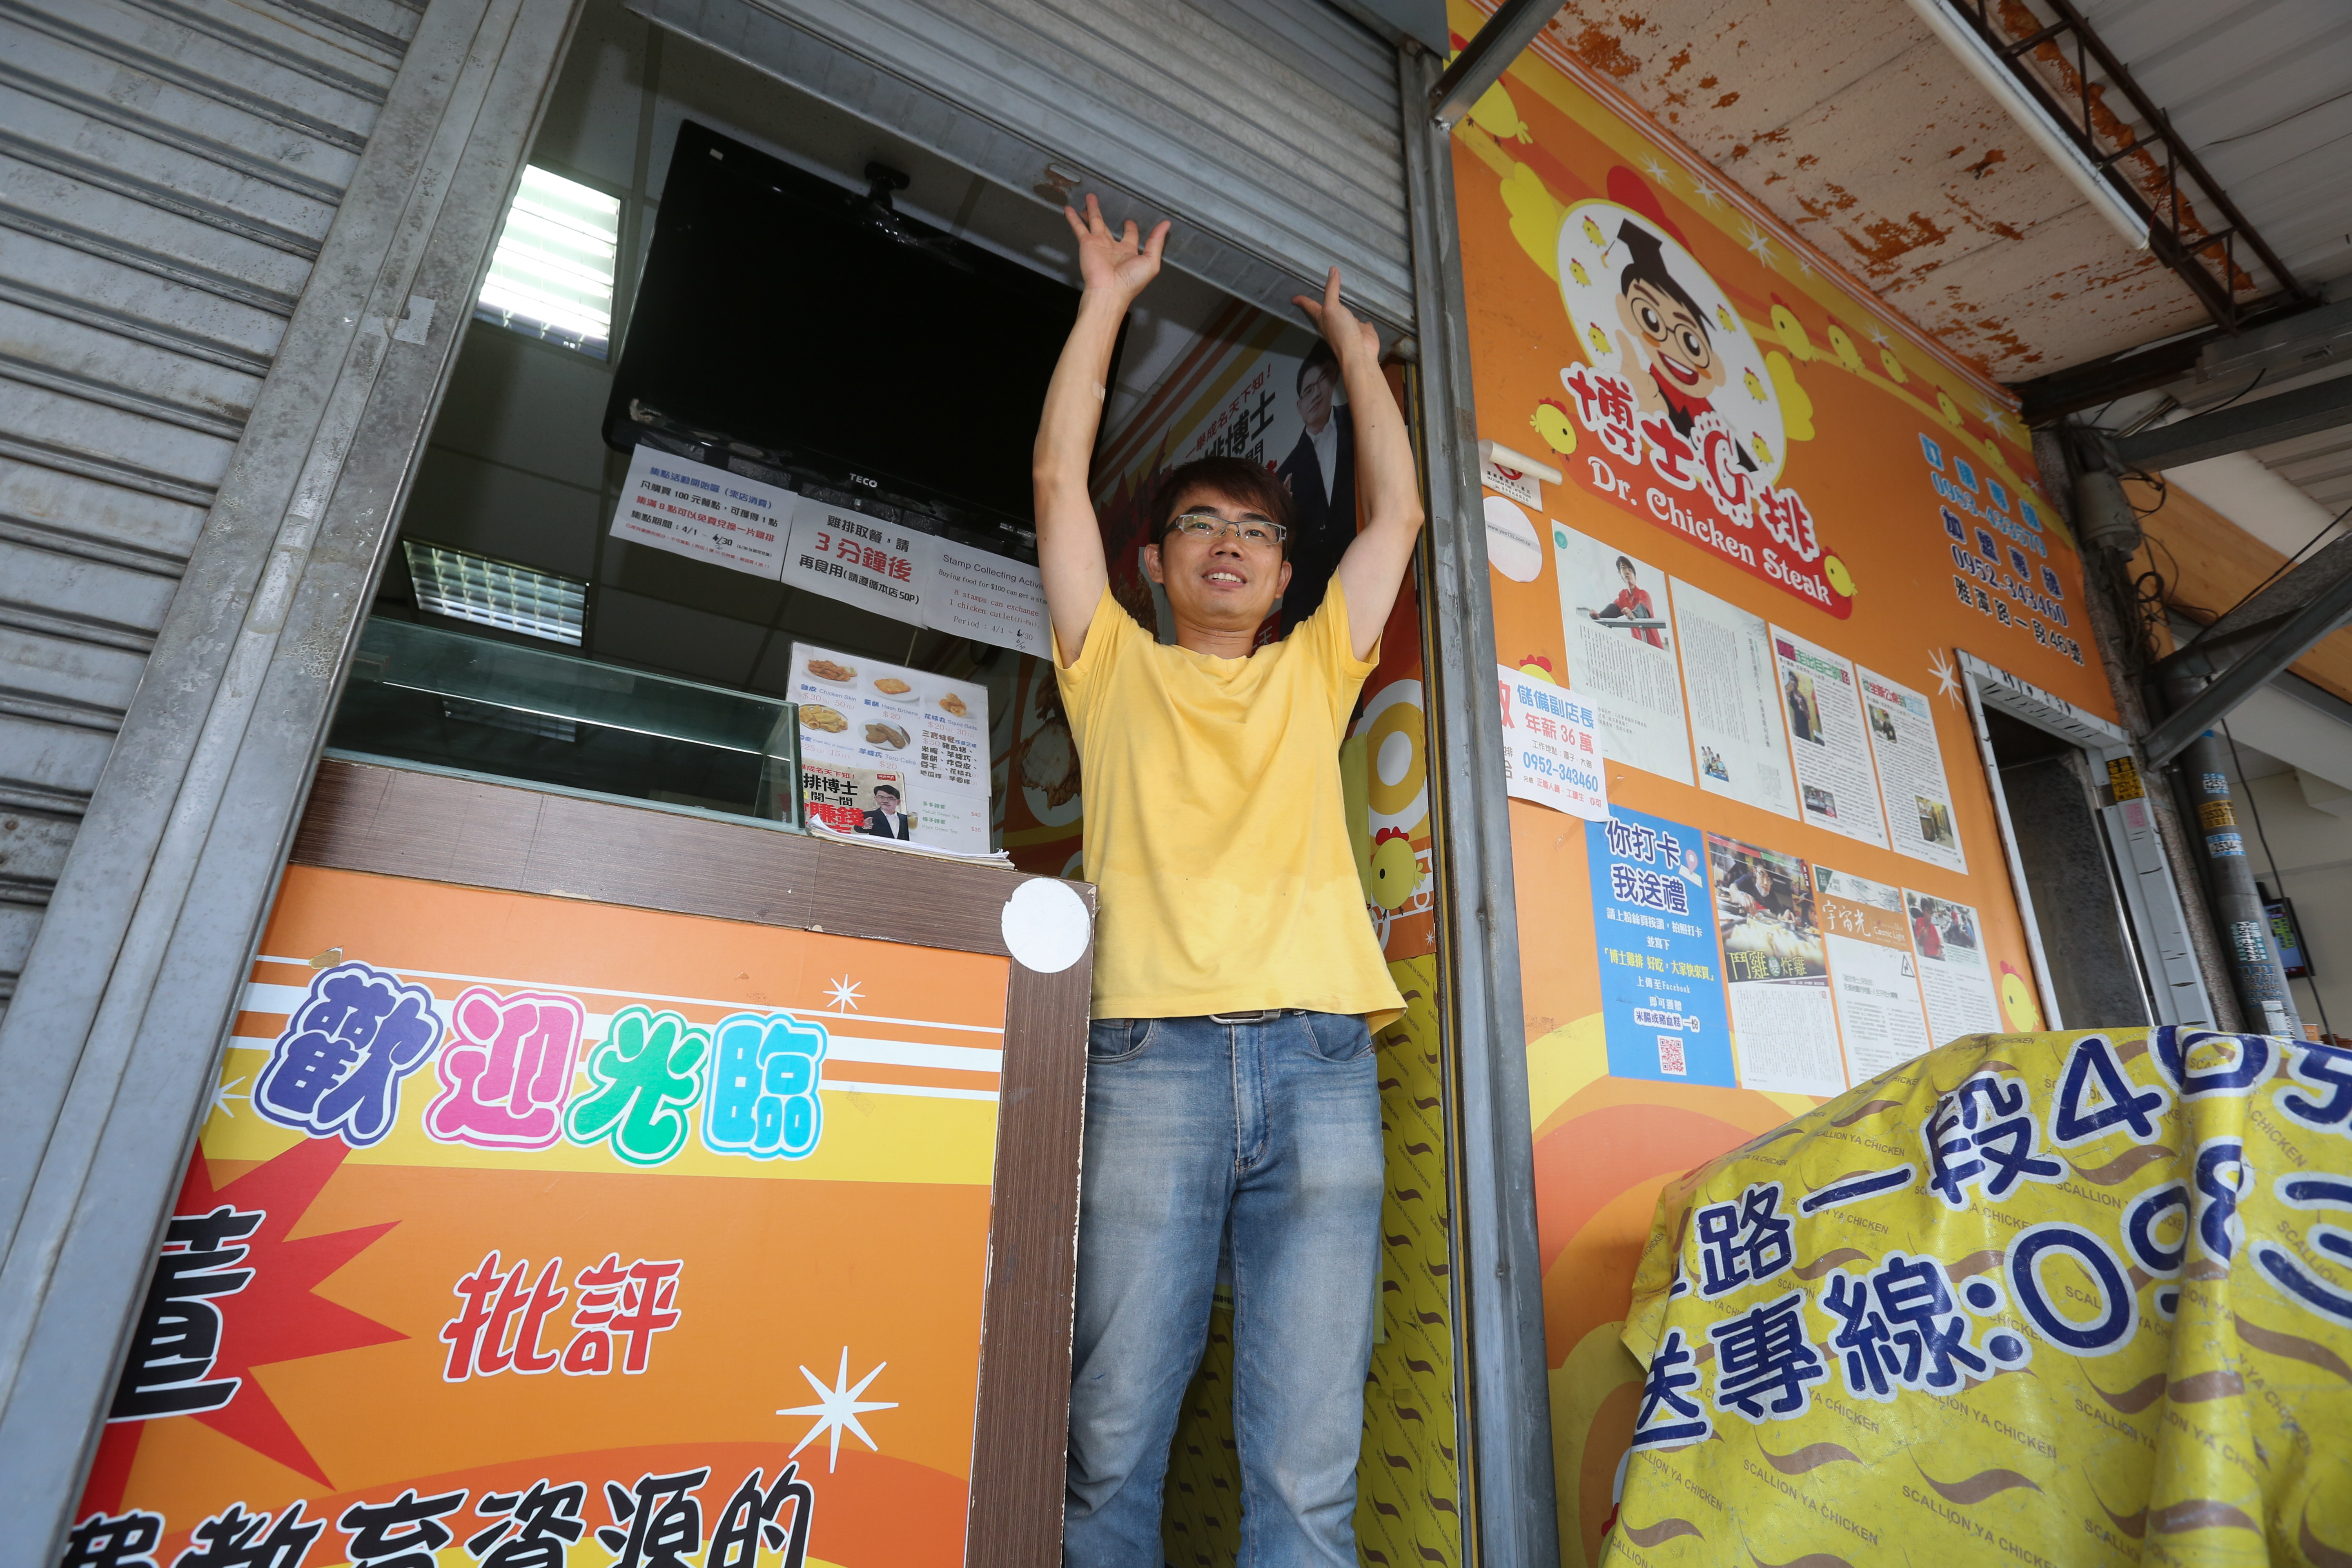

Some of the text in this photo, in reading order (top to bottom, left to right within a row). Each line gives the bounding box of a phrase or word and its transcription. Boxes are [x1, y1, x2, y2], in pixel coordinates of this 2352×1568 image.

[849, 473, 877, 488] TECO
[637, 495, 656, 508] 集滿
[640, 480, 671, 496] 凡購買
[675, 491, 689, 501] 100
[768, 517, 778, 527] 點
[827, 515, 909, 552] 雞排取餐，請
[1487, 523, 1531, 547] www.yes123.com.tw
[1588, 456, 1832, 606] Dr. Chicken Steak
[815, 532, 912, 582] 3 分鐘後
[943, 555, 971, 569] Stamp
[974, 564, 1016, 583] Collecting
[939, 569, 960, 581] Buying
[963, 576, 977, 586] food
[991, 582, 1005, 593] $100
[1018, 591, 1029, 601] get
[1951, 544, 2068, 627] 0952-343460
[957, 601, 986, 615] chicken
[962, 591, 987, 604] stamps
[991, 598, 1002, 607] can
[1007, 603, 1039, 617] exchange
[954, 616, 980, 629] Period
[991, 624, 1004, 635] 4/1
[820, 688, 842, 698] Chicken
[1517, 684, 1594, 729] 儲備副店長
[882, 703, 896, 712] Hash
[898, 706, 918, 716] Browns
[924, 713, 946, 724] 花枝丸
[948, 719, 962, 727] Squid
[957, 728, 967, 736] 30
[1525, 713, 1593, 754] 年薪 36 萬
[804, 773, 858, 795] 排博士
[1523, 752, 1598, 792] 0952-343460
[811, 791, 852, 806] 開一間
[804, 802, 865, 826] 賺錢
[1606, 820, 1681, 869] 你打卡
[1611, 863, 1689, 915] 我送禮
[1646, 936, 1670, 949] 並寫下
[1649, 996, 1682, 1011] 即可獲贈
[252, 959, 828, 1167] 歡迎光臨
[1850, 1135, 1862, 1144] YA
[1864, 1139, 1905, 1157] CHICKEN
[1388, 1189, 1421, 1237] SCALLION YA CHICKEN
[1833, 1209, 1889, 1234] YA CHICKEN
[441, 1250, 685, 1383] 批評
[1973, 1408, 2057, 1459] YA CHICKEN
[1742, 1459, 1877, 1546] SCALLION YA CHICKEN
[1902, 1485, 1994, 1544] SCALLION YA
